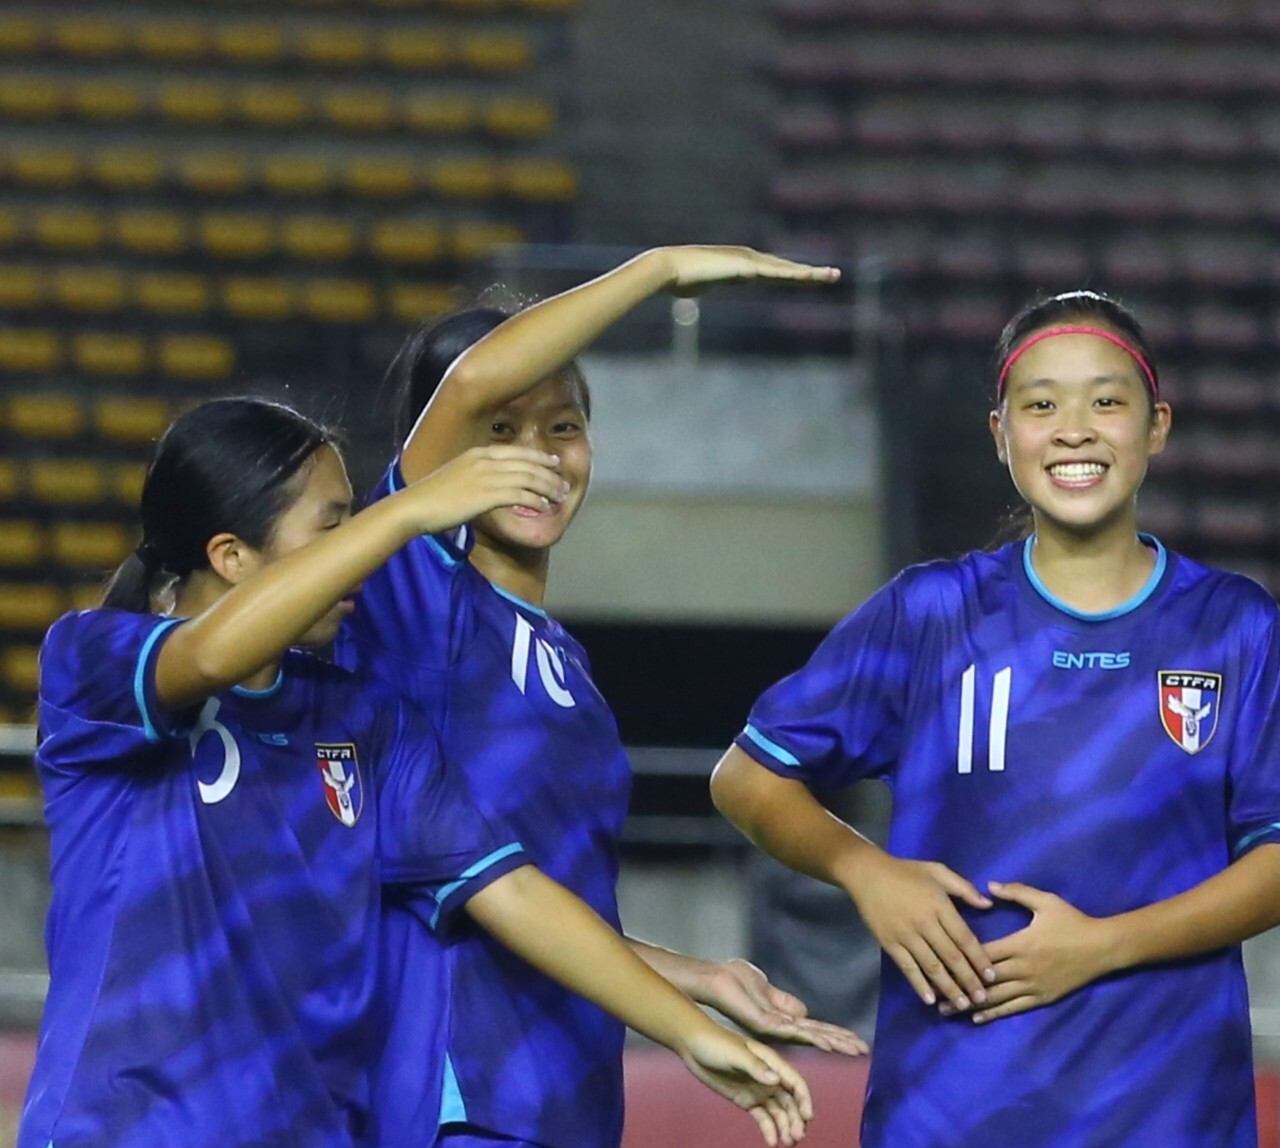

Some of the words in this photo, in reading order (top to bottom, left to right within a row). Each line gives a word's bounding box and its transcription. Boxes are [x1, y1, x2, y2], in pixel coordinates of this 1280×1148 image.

[1053, 651, 1130, 669] ENTES
[1164, 674, 1216, 690] CTFA
[958, 664, 1011, 773] 11
[317, 748, 351, 759] CTFA
